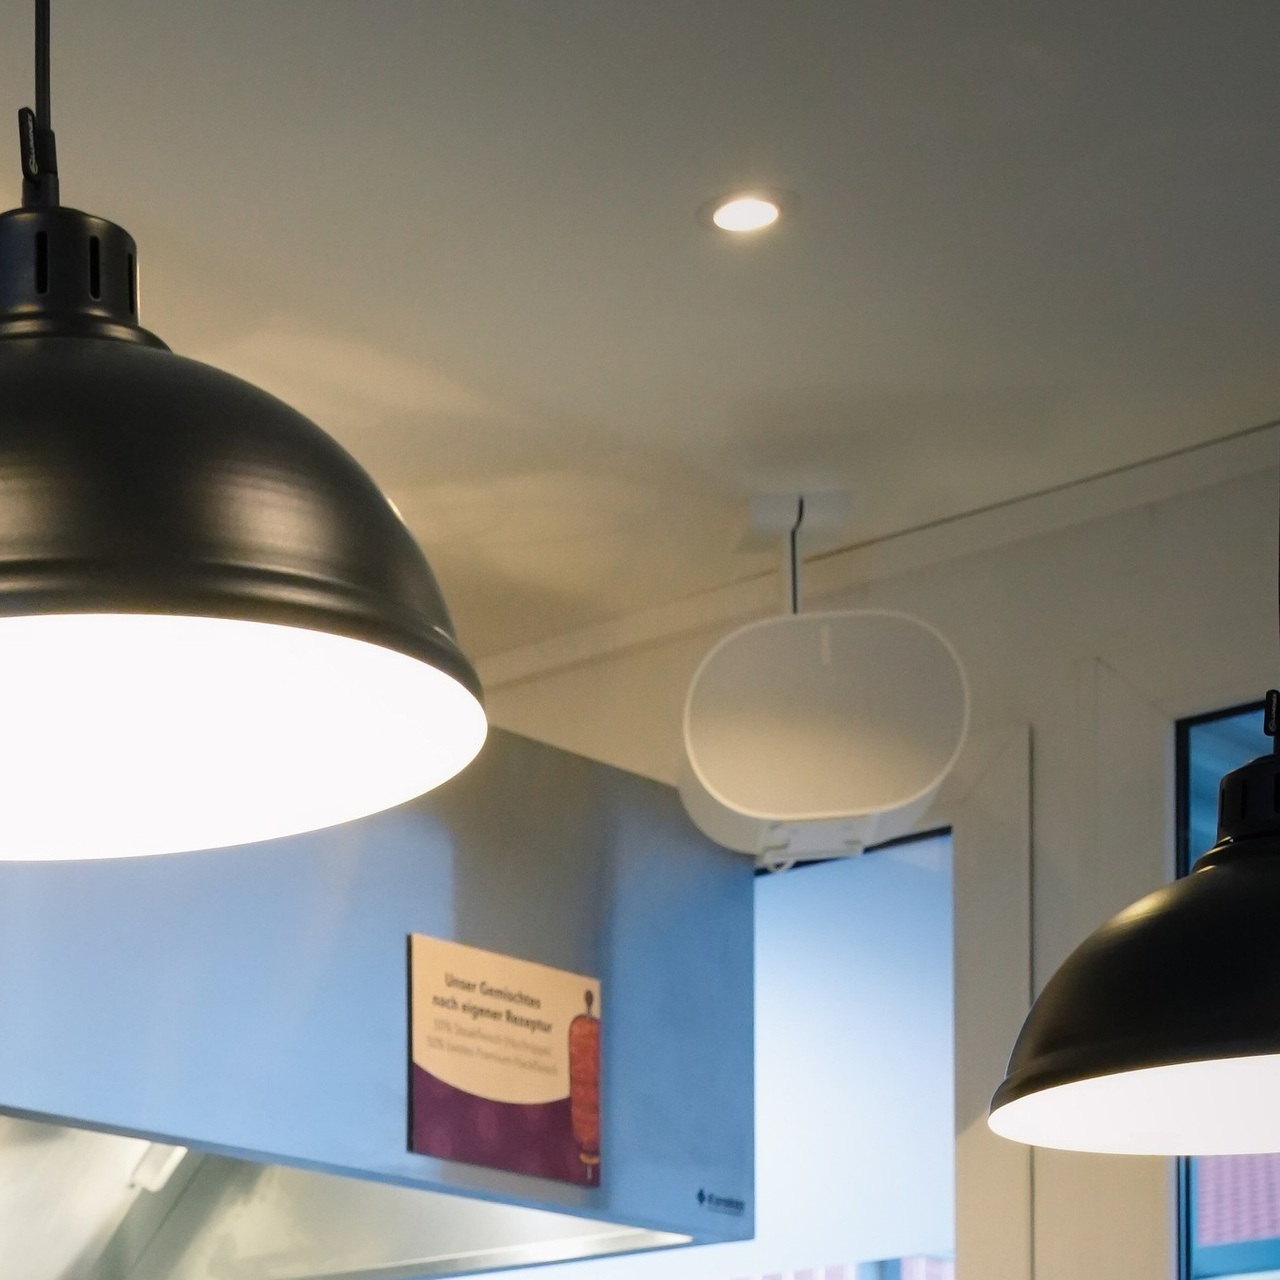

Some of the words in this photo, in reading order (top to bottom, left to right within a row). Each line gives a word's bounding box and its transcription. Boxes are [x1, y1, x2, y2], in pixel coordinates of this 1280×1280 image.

[444, 972, 476, 992] Unser
[479, 980, 541, 1010] Gemischtes
[432, 995, 459, 1010] nach
[461, 1002, 502, 1020] eigener
[505, 1009, 553, 1034] Rezeptur
